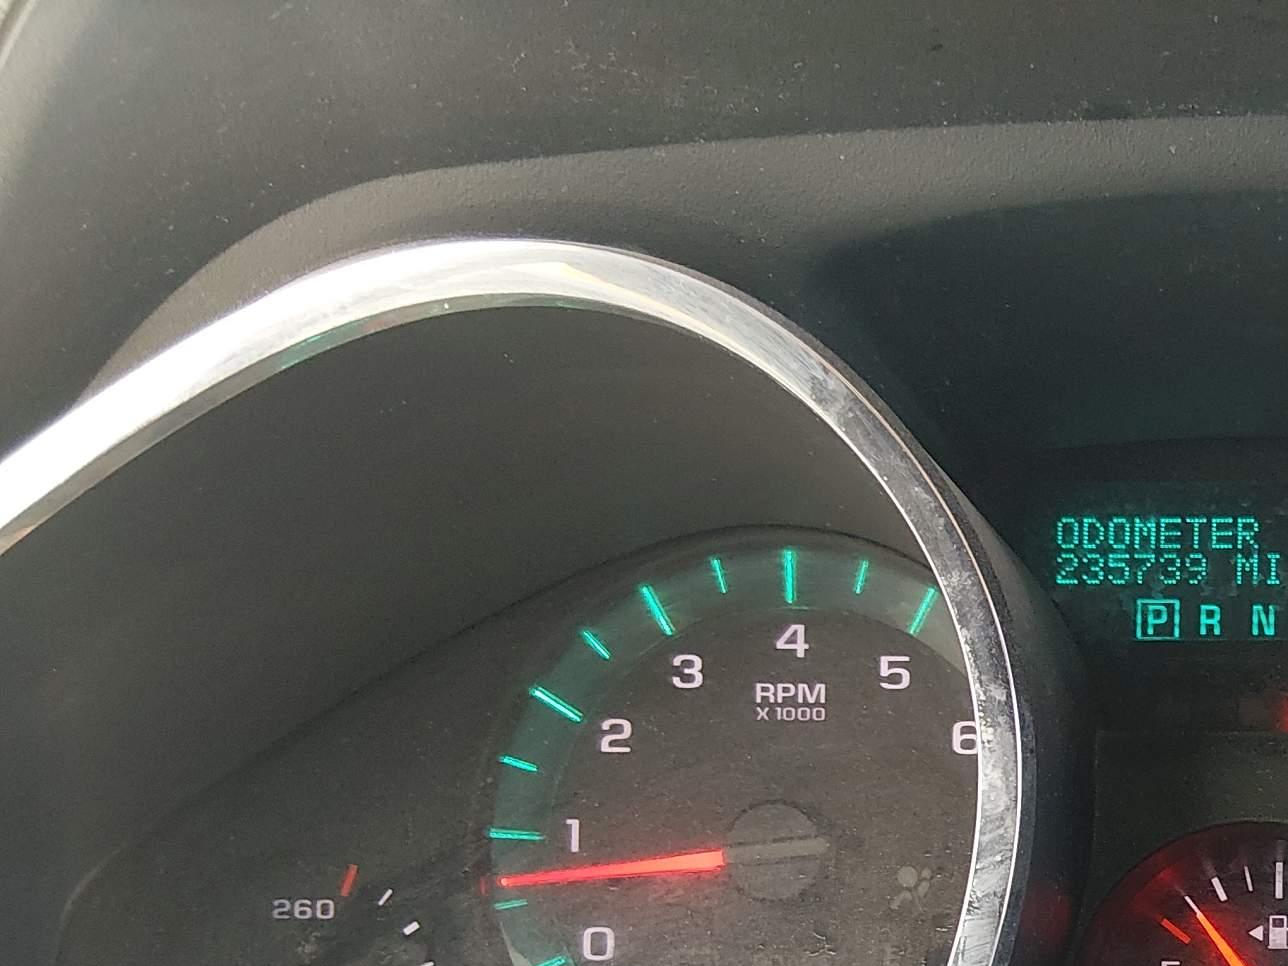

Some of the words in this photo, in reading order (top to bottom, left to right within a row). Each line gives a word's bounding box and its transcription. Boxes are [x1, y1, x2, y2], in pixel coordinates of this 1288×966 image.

[1057, 516, 1259, 551] ODOMETER
[1056, 551, 1207, 586] 235739
[1236, 552, 1281, 586] MI
[1146, 604, 1169, 636] P
[1199, 604, 1221, 636] R
[1251, 604, 1275, 636] N
[775, 624, 810, 658] 4
[671, 654, 704, 689] 3
[879, 655, 911, 690] 5
[755, 682, 826, 704] RPM
[600, 718, 632, 753] 2
[951, 720, 980, 756] 6
[565, 818, 581, 853] 1
[272, 899, 335, 920] 260
[582, 926, 615, 961] 0
